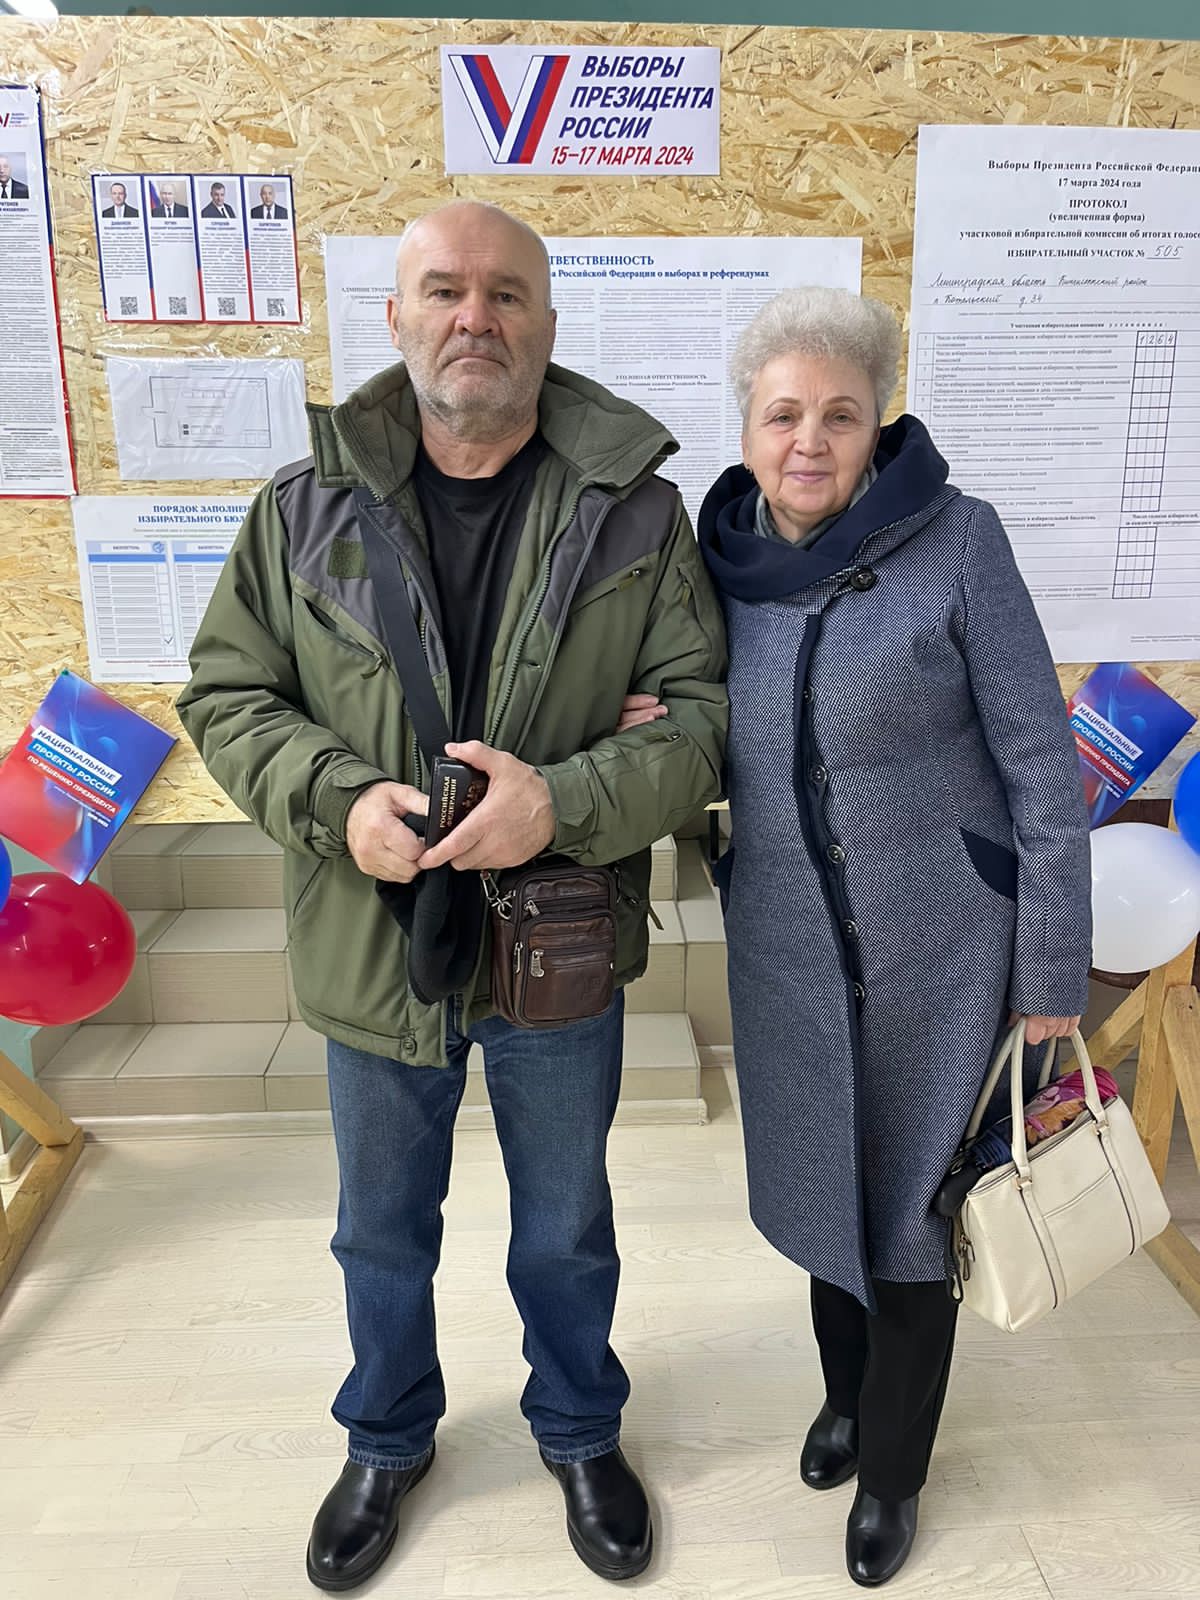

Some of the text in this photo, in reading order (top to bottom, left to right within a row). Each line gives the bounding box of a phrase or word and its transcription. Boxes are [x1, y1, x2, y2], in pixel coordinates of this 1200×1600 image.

[581, 55, 685, 77] ВЫБОРЫ
[570, 86, 714, 111] ПРЕЗИДЕНТА
[559, 117, 652, 138] РОССИИ
[597, 147, 651, 165] МАРТА
[655, 146, 694, 165] 2024
[988, 160, 1030, 172] Выборы
[1033, 160, 1092, 172] Президента
[1095, 161, 1153, 172] Российской
[1058, 178, 1142, 189] 17 марта 2024 года
[1069, 199, 1128, 209] ПРОТОКОЛ
[1049, 212, 1145, 223] (увеличенная форма)
[959, 229, 1012, 240] участковой
[1015, 229, 1083, 240] избирательной
[1084, 230, 1127, 239] комиссии
[1129, 230, 1140, 239] об
[1142, 231, 1171, 239] итогах
[1007, 248, 1088, 258] ИЗБИРАТЕЛЬНЫЙ
[1090, 249, 1134, 258] УЧАСТОК
[1154, 245, 1183, 257] 505
[549, 255, 655, 266] ТВЕТСТВЕННОСТЬ
[558, 270, 607, 278] Российской
[609, 270, 655, 280] Федерации
[665, 270, 701, 279] выборах
[709, 270, 769, 280] референдумах
[153, 505, 250, 514] ПОРЯДОК ЗАПОЛНЕН
[138, 515, 222, 523] ИЗБИРАТЕЛЬНОГО
[1077, 706, 1139, 757] НАЦИОНАЛЬНЫЕ
[1071, 719, 1135, 772] ПРОЕКТЫ РОССИИ
[38, 729, 117, 782] НАЦИОНАЛЬНЫЕ
[32, 743, 116, 798] ПРОЕКТЫ РОССИИ
[27, 755, 39, 765] ПО
[72, 783, 116, 813] ПРЕЗИДЕНТА
[440, 776, 451, 828] РОССИЙСКАЯ
